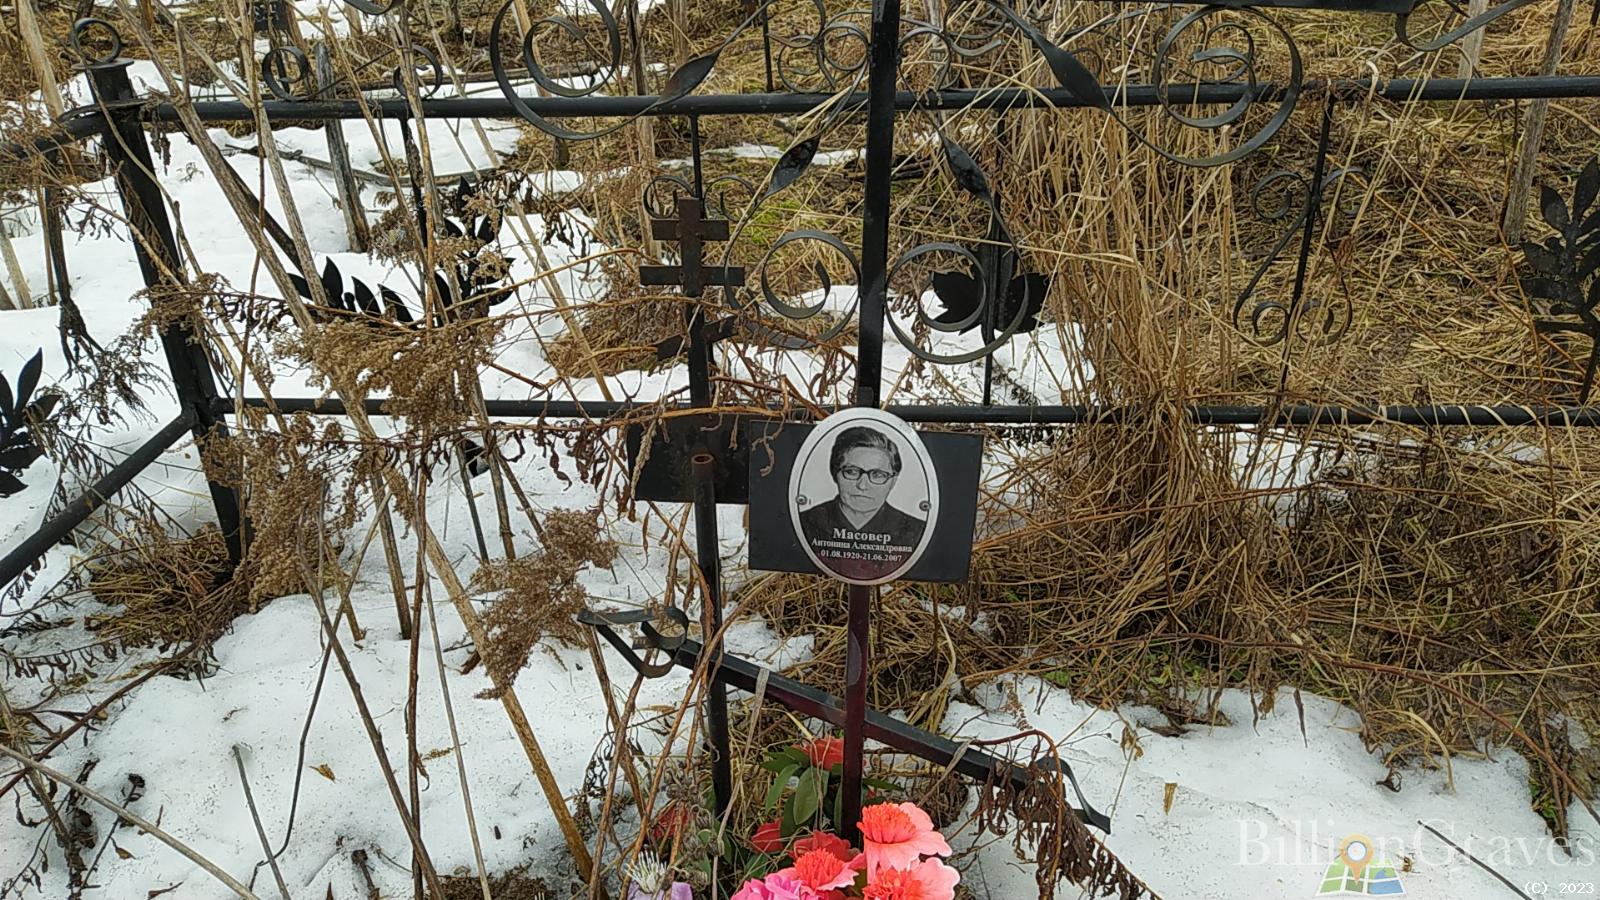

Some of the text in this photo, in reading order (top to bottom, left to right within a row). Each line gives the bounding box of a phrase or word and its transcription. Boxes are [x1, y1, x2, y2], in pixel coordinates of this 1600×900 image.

[833, 528, 891, 544] Масовер
[812, 538, 912, 553] Антонина Александровна
[821, 550, 902, 561] 01.08.1920-21.06.2007
